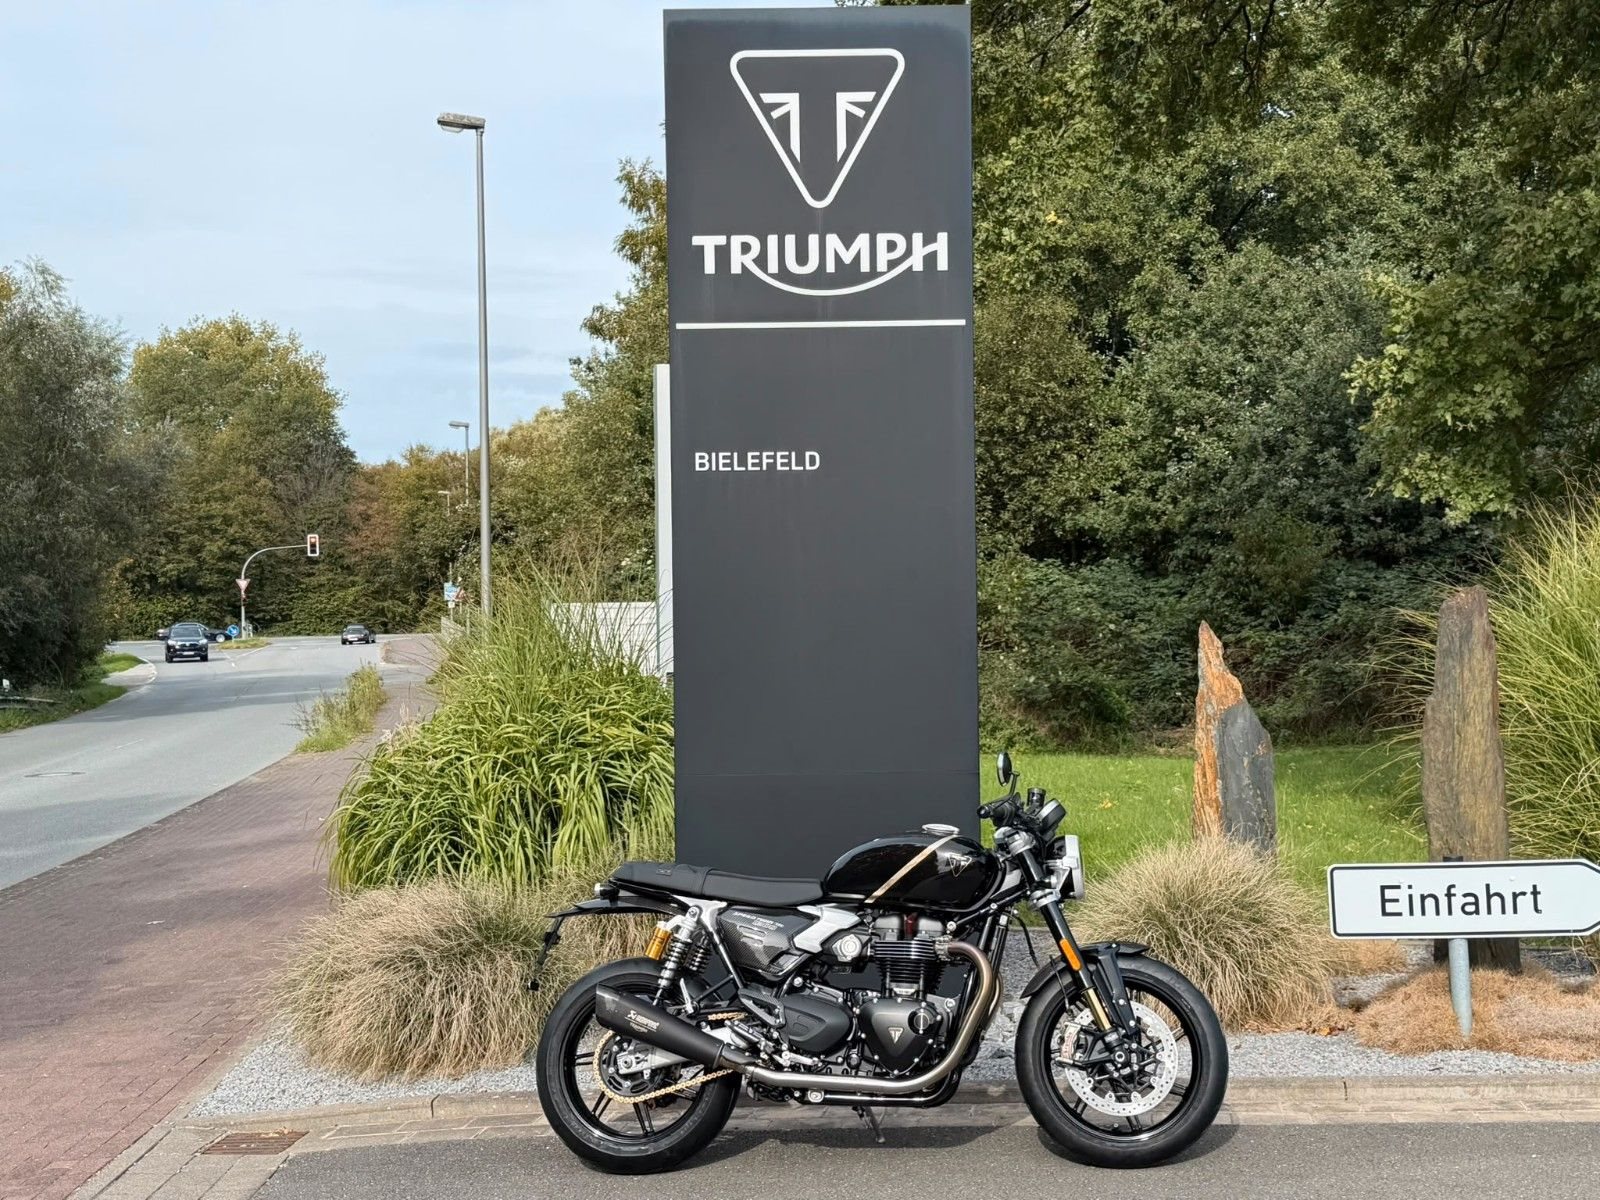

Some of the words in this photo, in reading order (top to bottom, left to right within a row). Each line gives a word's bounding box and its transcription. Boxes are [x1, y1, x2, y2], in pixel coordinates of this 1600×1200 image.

[692, 231, 949, 296] TRIUMPH
[694, 451, 821, 472] BIELEFELD
[1379, 883, 1543, 918] Einfahrt
